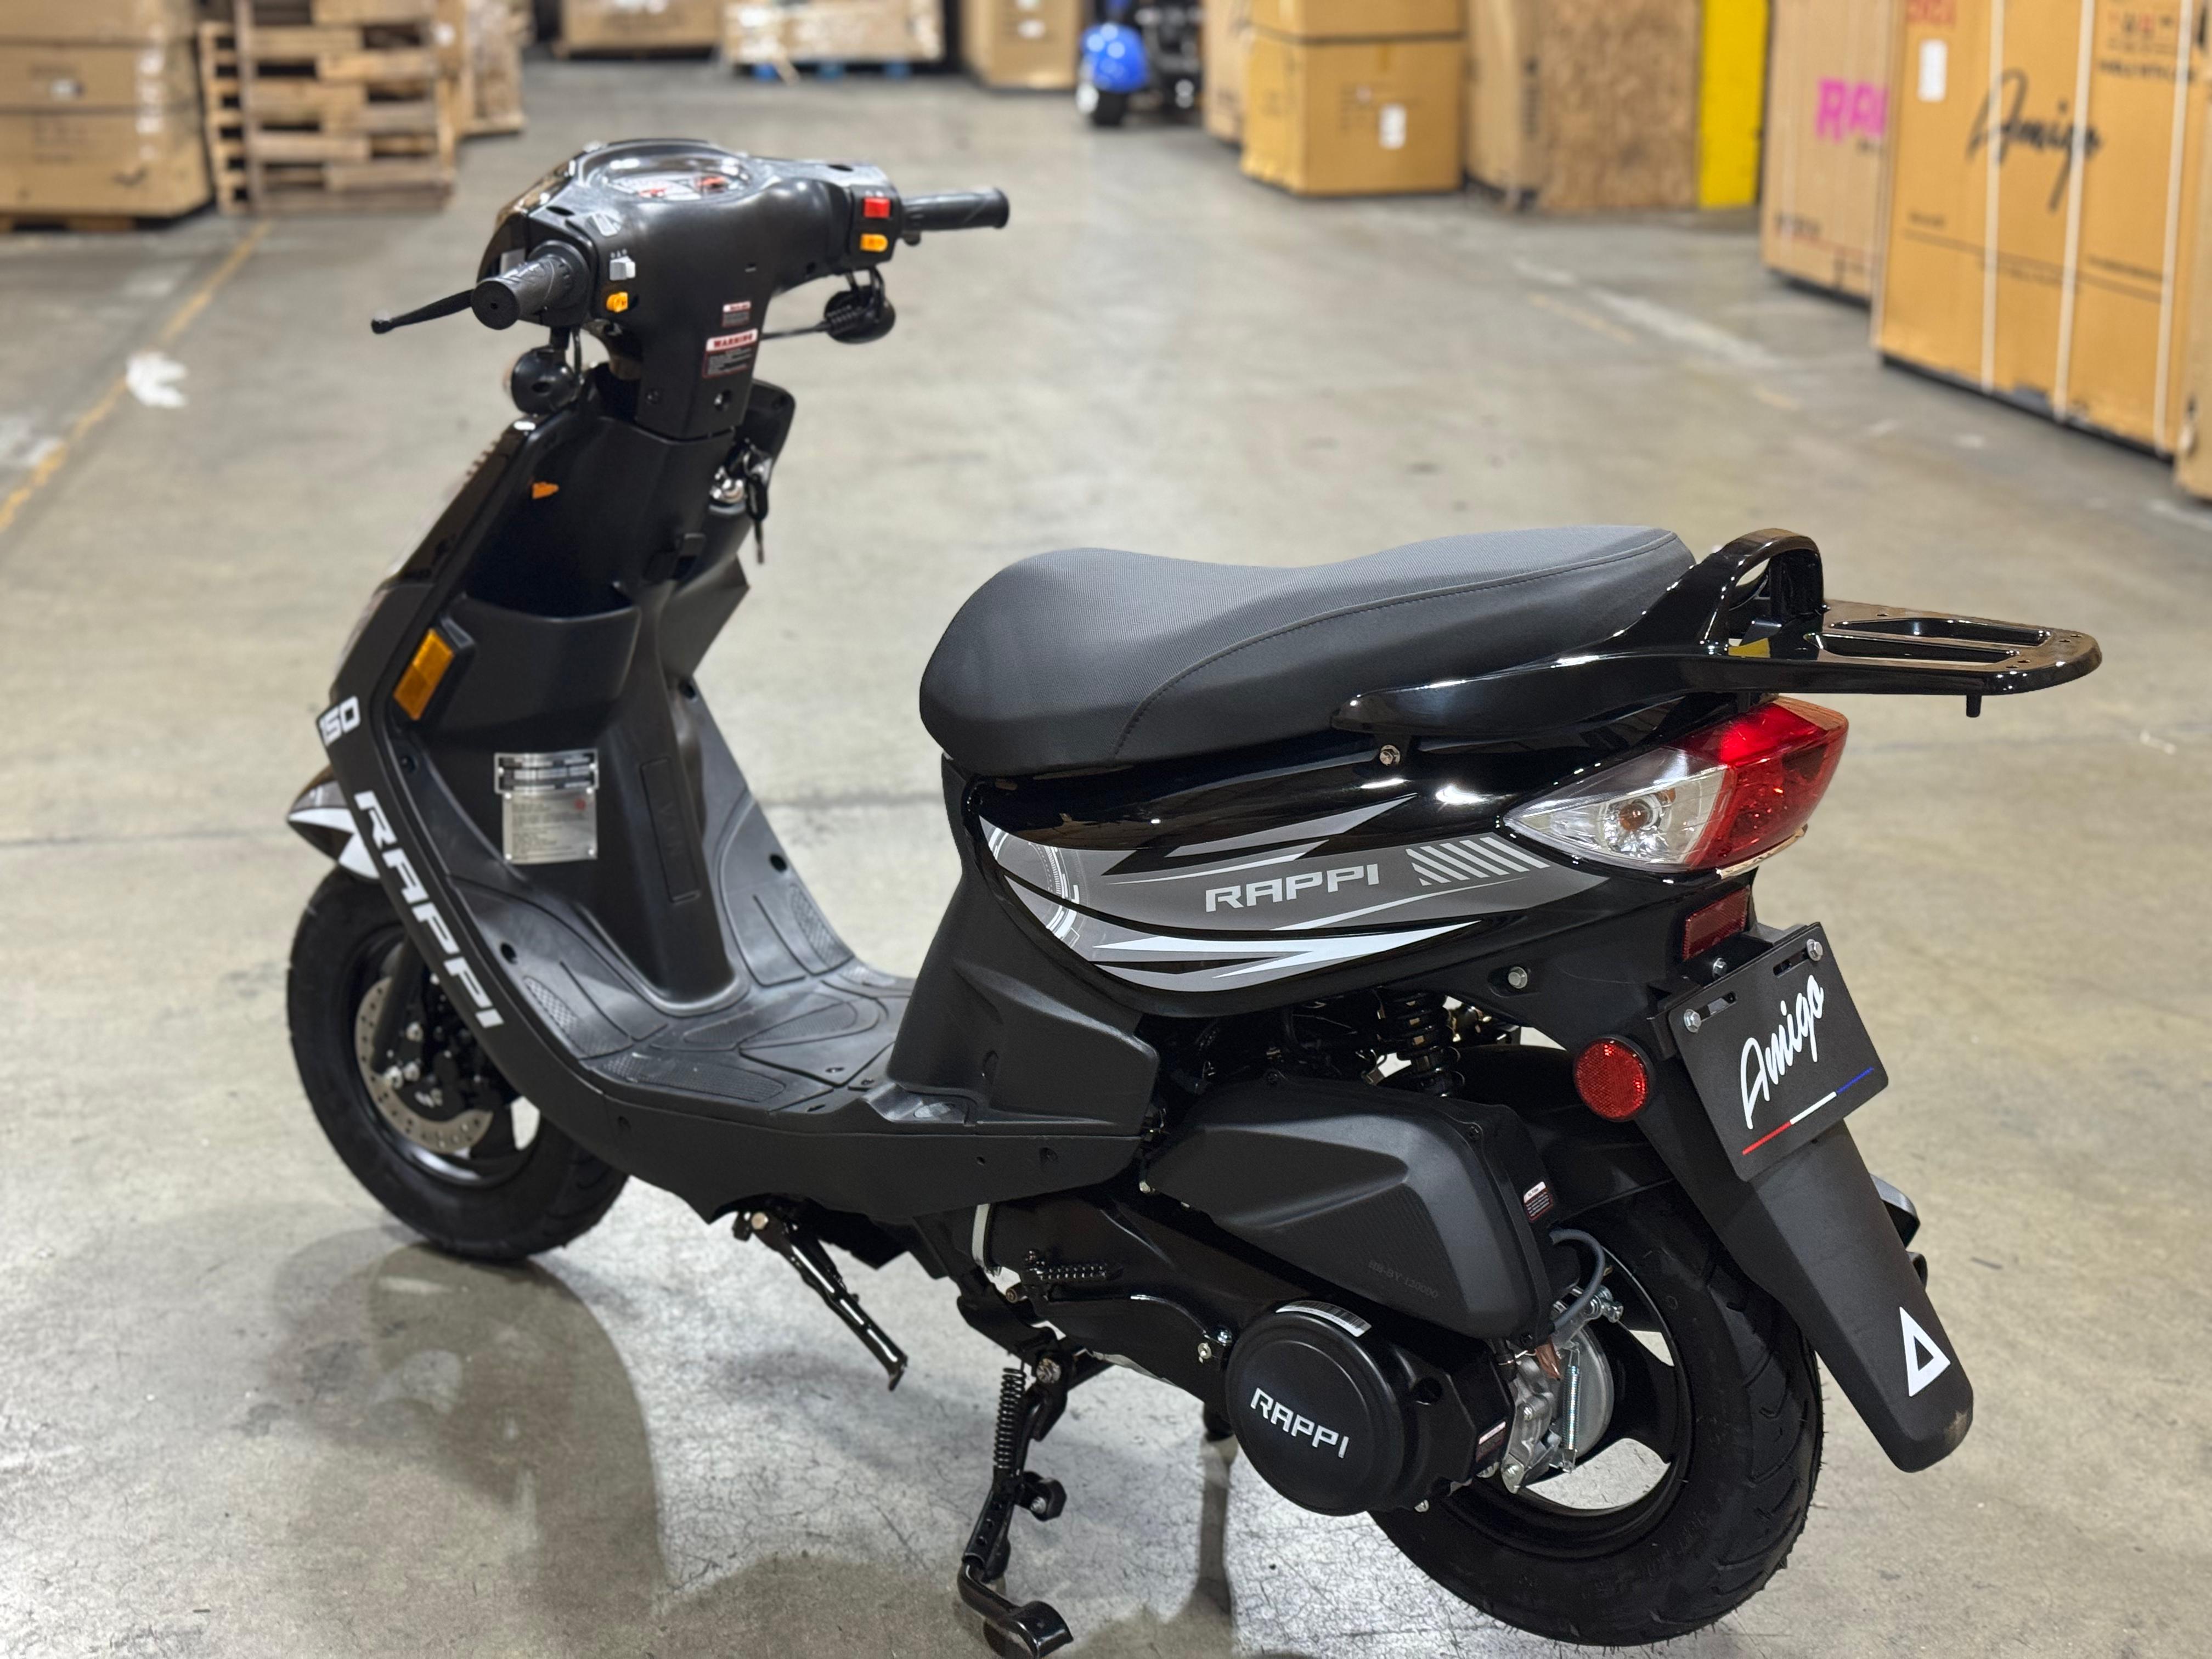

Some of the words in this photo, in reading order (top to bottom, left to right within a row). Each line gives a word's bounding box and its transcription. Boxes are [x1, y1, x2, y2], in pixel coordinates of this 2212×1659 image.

[1816, 78, 1887, 144] RA
[354, 791, 504, 1028] RAPPI
[1206, 864, 1379, 912] RAPPI
[1740, 974, 1824, 1129] Amigo
[1250, 1387, 1349, 1458] RAPPI
